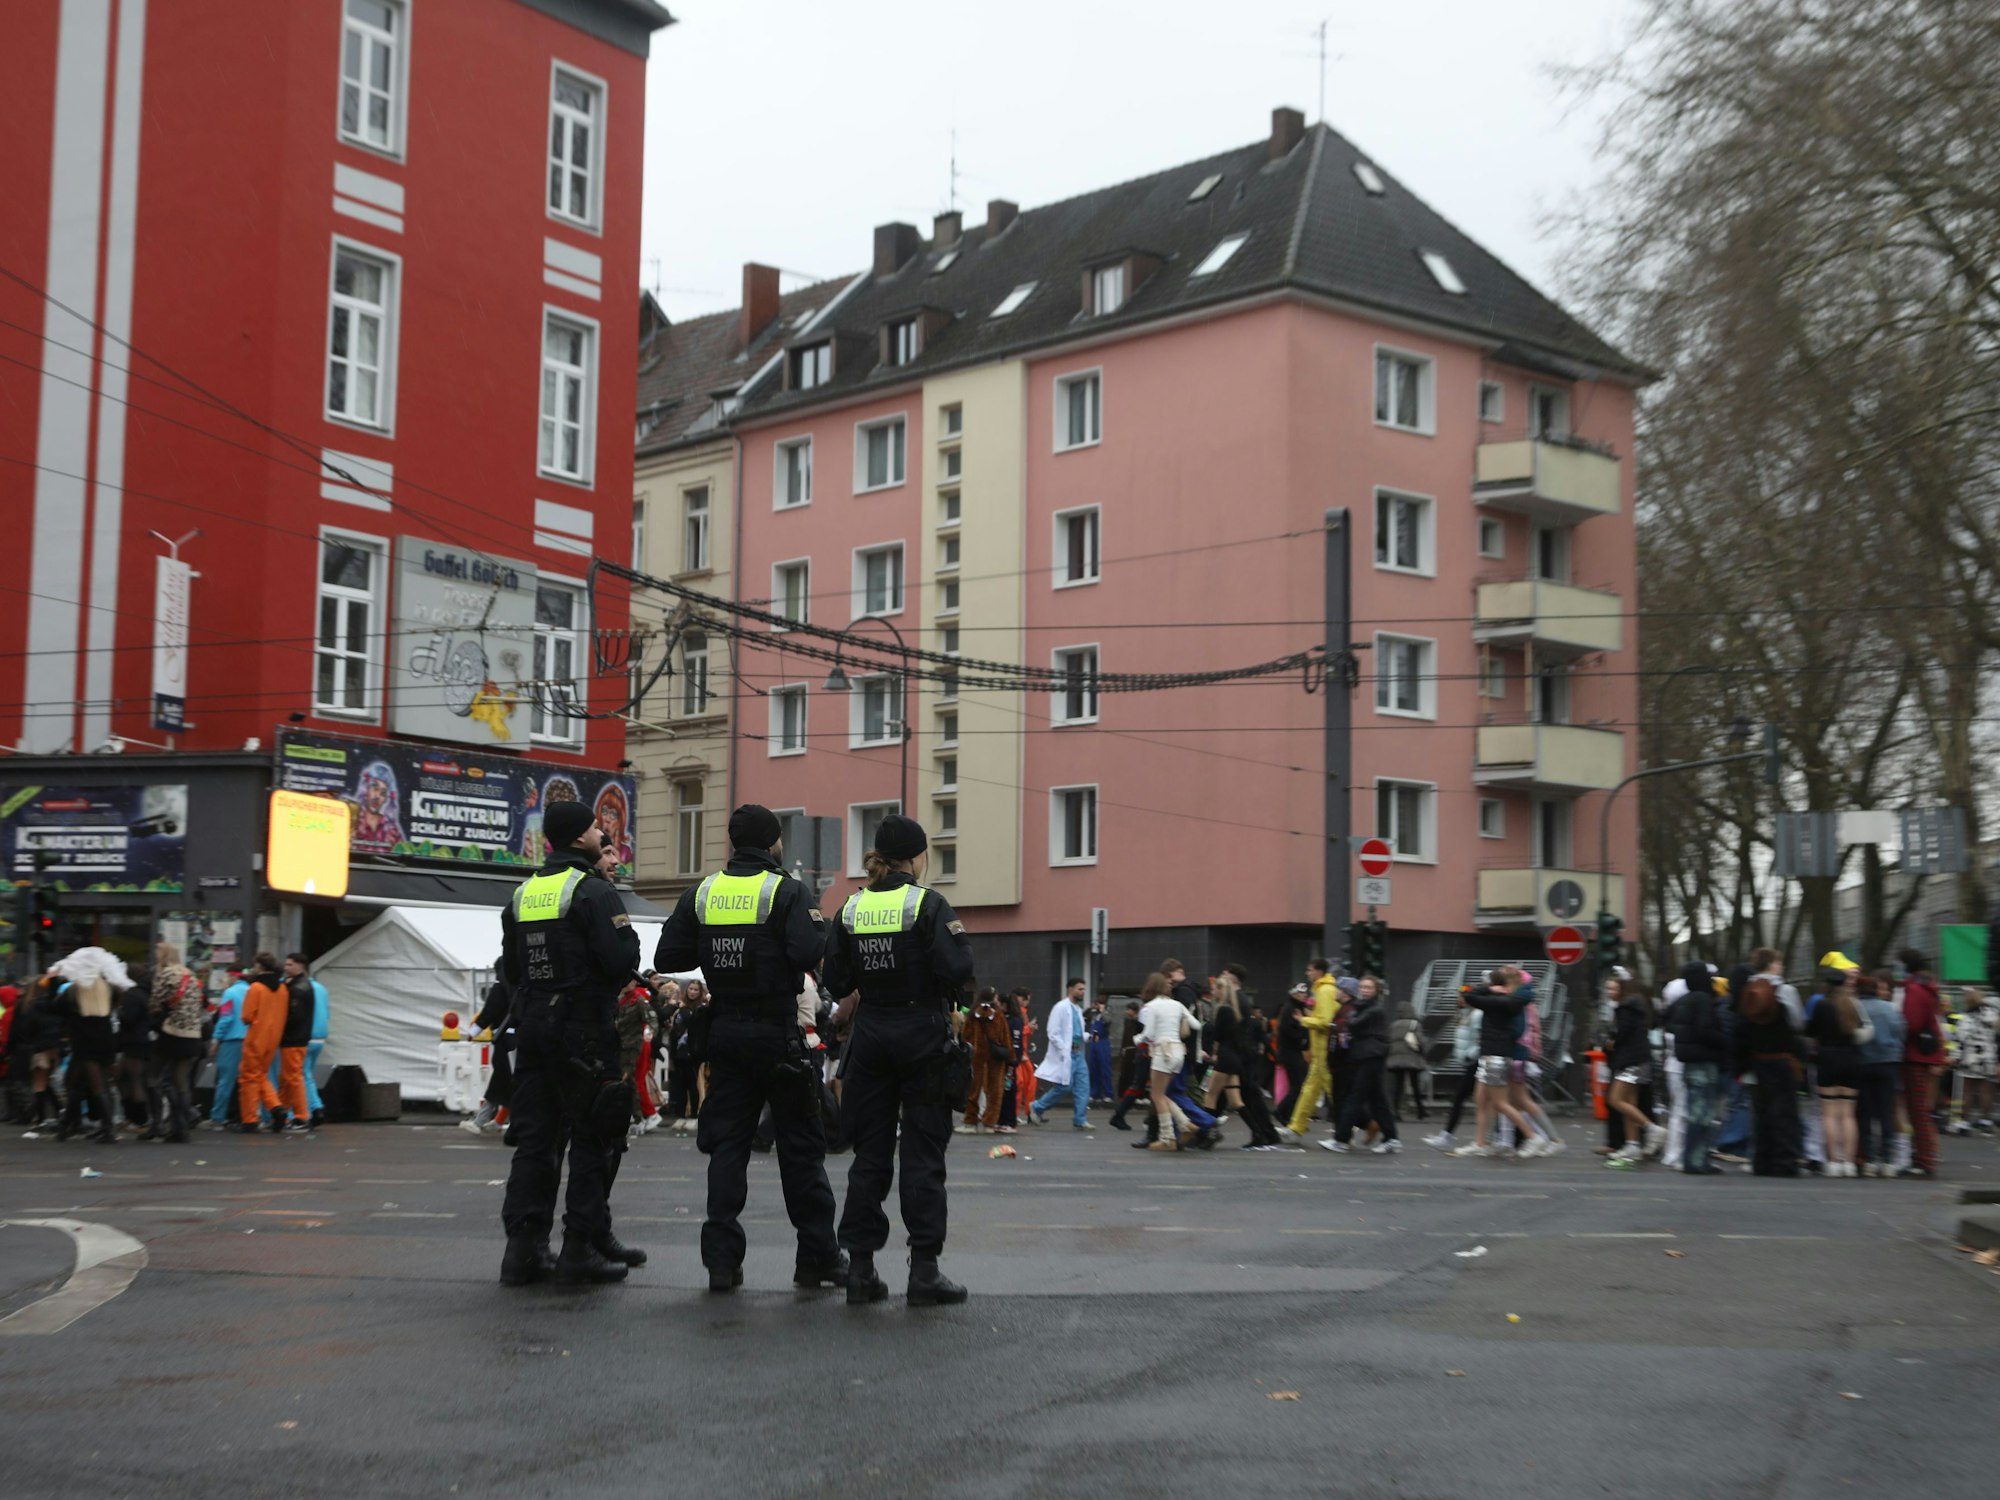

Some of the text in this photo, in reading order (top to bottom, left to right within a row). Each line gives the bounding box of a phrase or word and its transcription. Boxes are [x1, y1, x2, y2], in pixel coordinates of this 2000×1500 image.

[411, 790, 509, 827] KLIMAKTERIUM
[410, 821, 509, 842] SCHLÄGT ZURÜCK
[523, 893, 558, 909] POLIZEI
[710, 895, 754, 910] POLIZEI
[855, 909, 901, 927] POLIZEI
[526, 932, 545, 946] NRW
[712, 938, 745, 952] NRW
[859, 937, 893, 953] NRW
[528, 948, 548, 963] 264
[713, 953, 743, 968] 2641
[863, 954, 896, 970] 2641
[528, 965, 554, 980] BeSi
